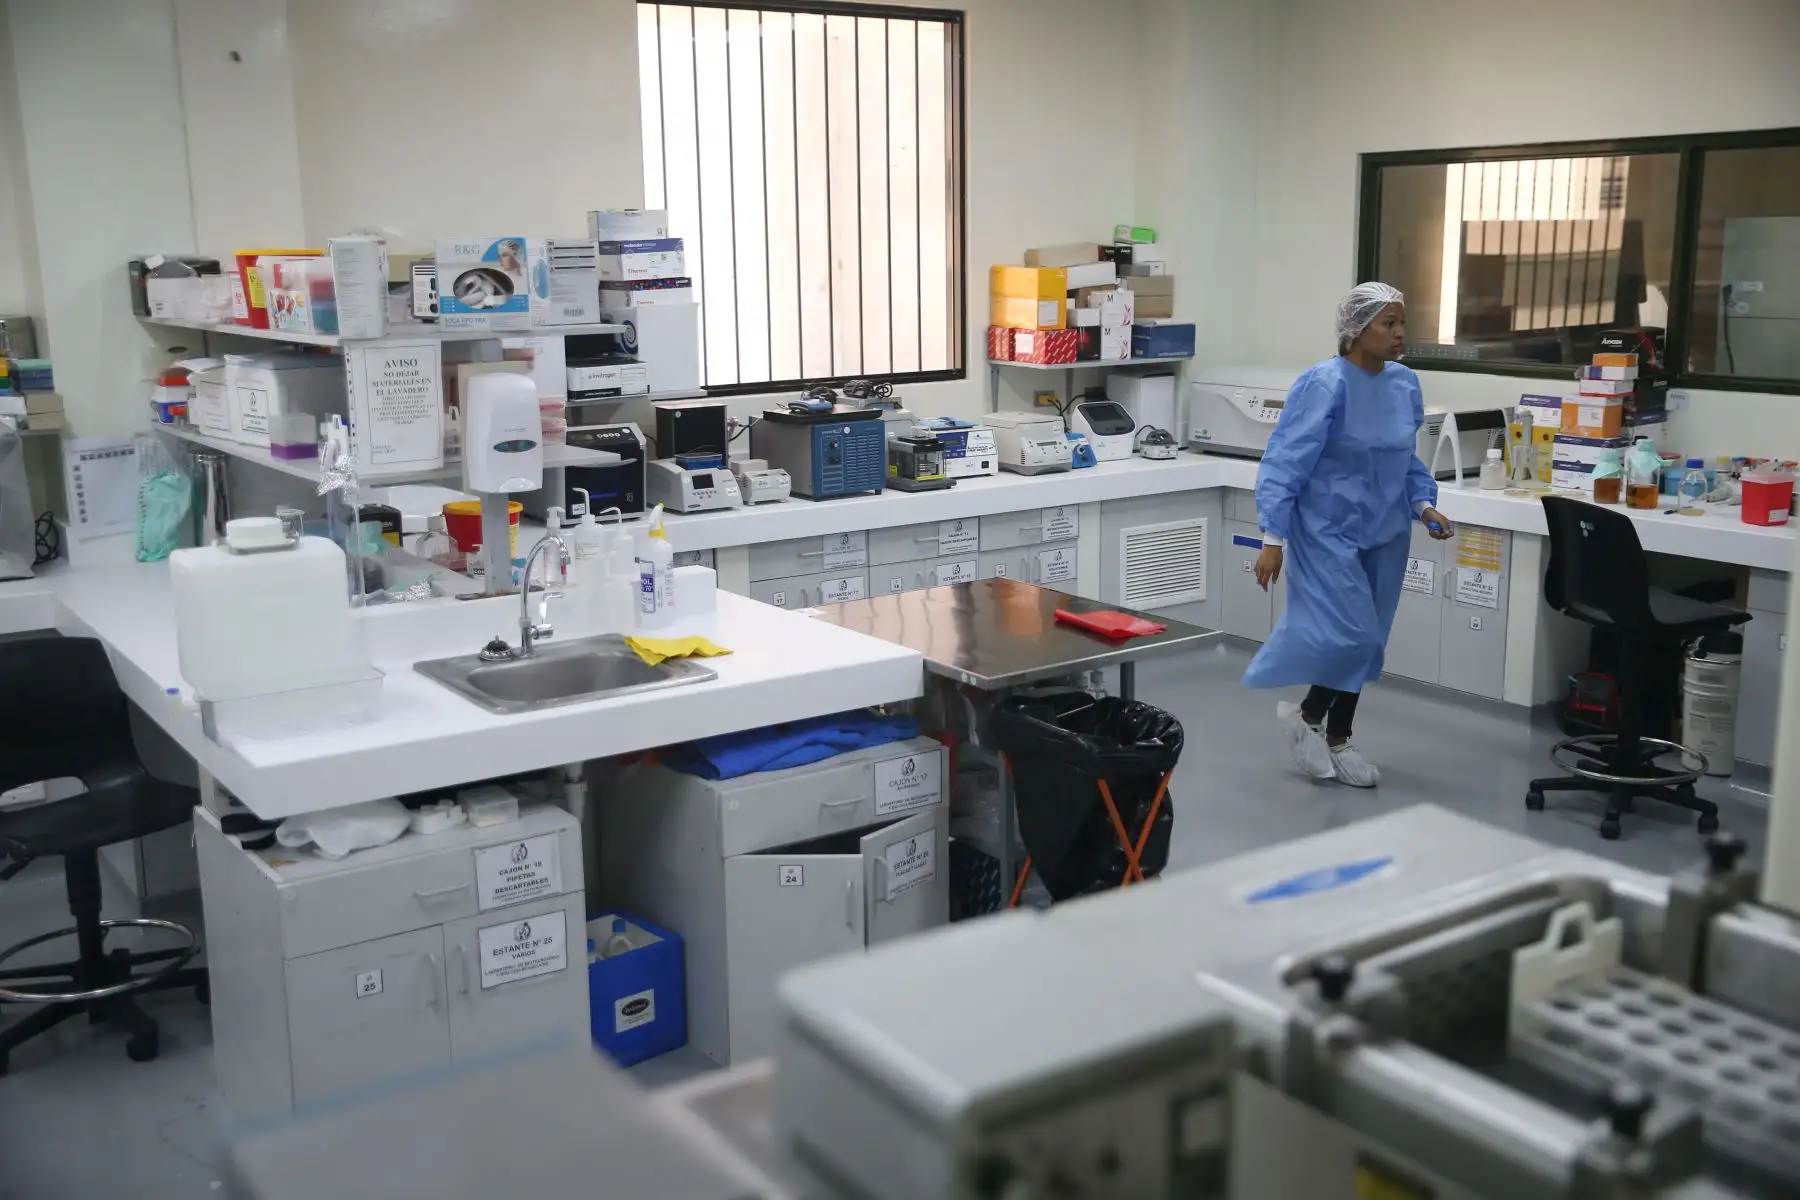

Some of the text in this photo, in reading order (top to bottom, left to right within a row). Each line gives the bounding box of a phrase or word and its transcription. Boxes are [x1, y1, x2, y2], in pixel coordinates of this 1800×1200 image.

[384, 358, 418, 369] AVISO
[784, 875, 797, 883] 24
[492, 941, 531, 956] ESTANTE
[543, 936, 553, 945] 25
[511, 949, 536, 960] VARIOS
[363, 982, 376, 992] 25
